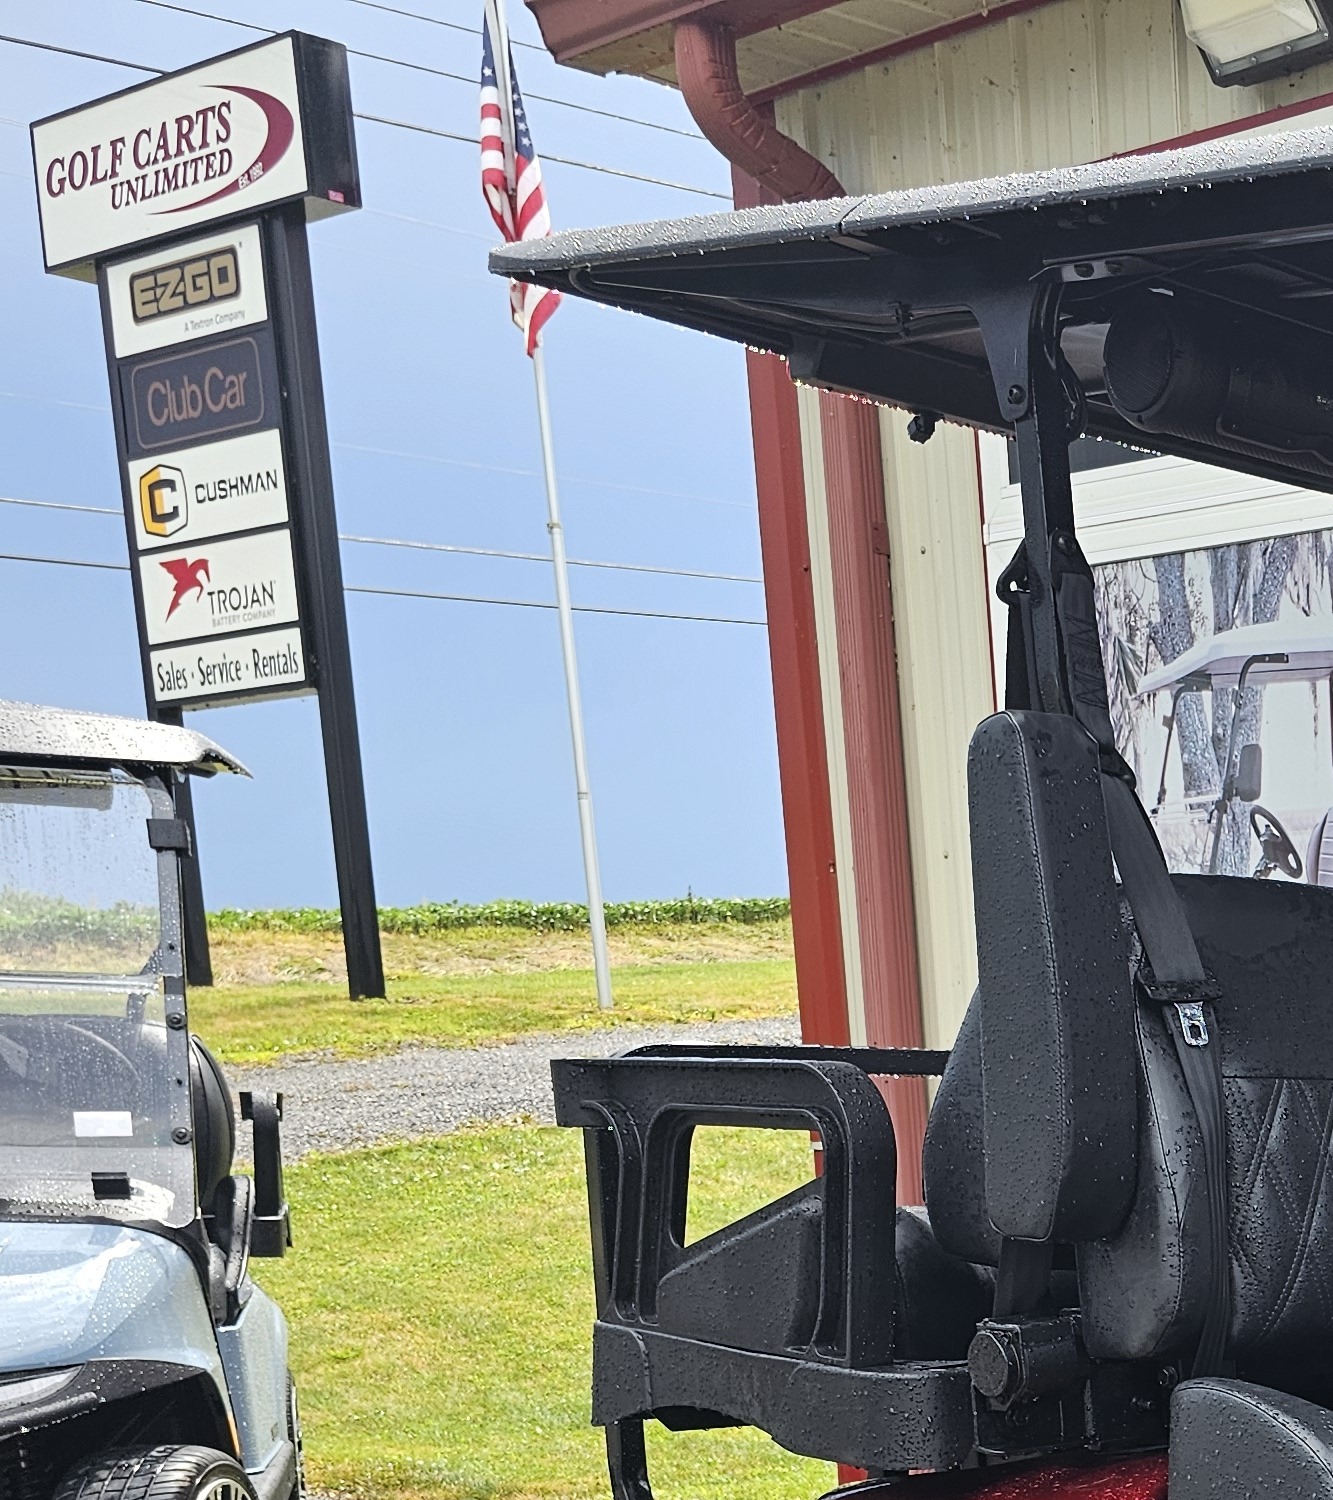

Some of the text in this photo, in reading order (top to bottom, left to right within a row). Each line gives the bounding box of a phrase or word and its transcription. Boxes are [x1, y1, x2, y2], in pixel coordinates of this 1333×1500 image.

[46, 101, 232, 198] GOLF CARTS
[111, 148, 233, 210] UNLIMITED
[190, 317, 214, 331] Textron
[215, 309, 246, 326] Company
[147, 366, 248, 427] Club Car
[195, 469, 279, 504] CUSHMAN
[207, 580, 276, 616] TROJAN
[212, 608, 276, 628] BATTERY COMPANY
[157, 643, 299, 692] Sales Service Rentals
